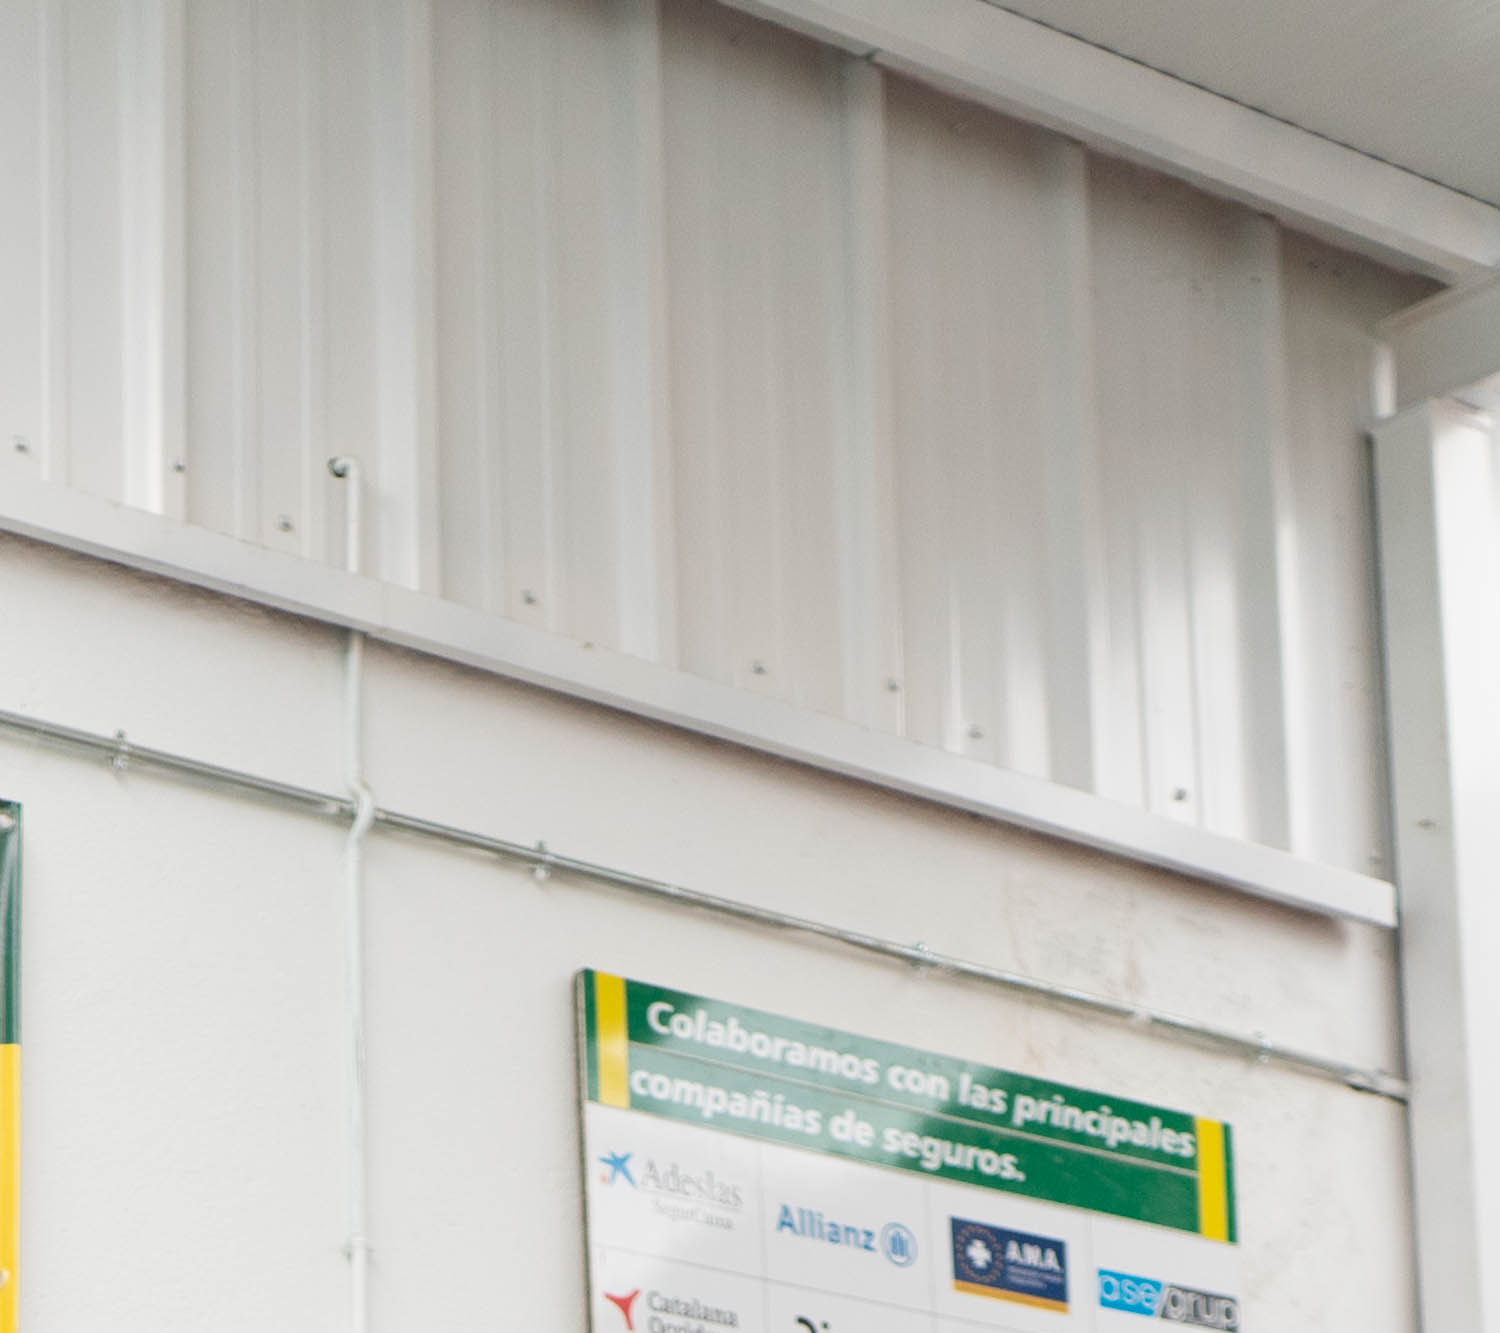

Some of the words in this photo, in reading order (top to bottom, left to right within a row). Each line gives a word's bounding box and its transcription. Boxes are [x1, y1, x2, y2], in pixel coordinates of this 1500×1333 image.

[647, 1001, 880, 1084] Colaboramos
[887, 1065, 949, 1101] con
[958, 1073, 1007, 1114] las
[1013, 1094, 1197, 1157] principales
[829, 1110, 875, 1146] de
[882, 1124, 1026, 1182] seguros.
[641, 1158, 743, 1208] Adeslas
[775, 1203, 877, 1254] Allianz
[648, 1291, 739, 1329] Catalana
